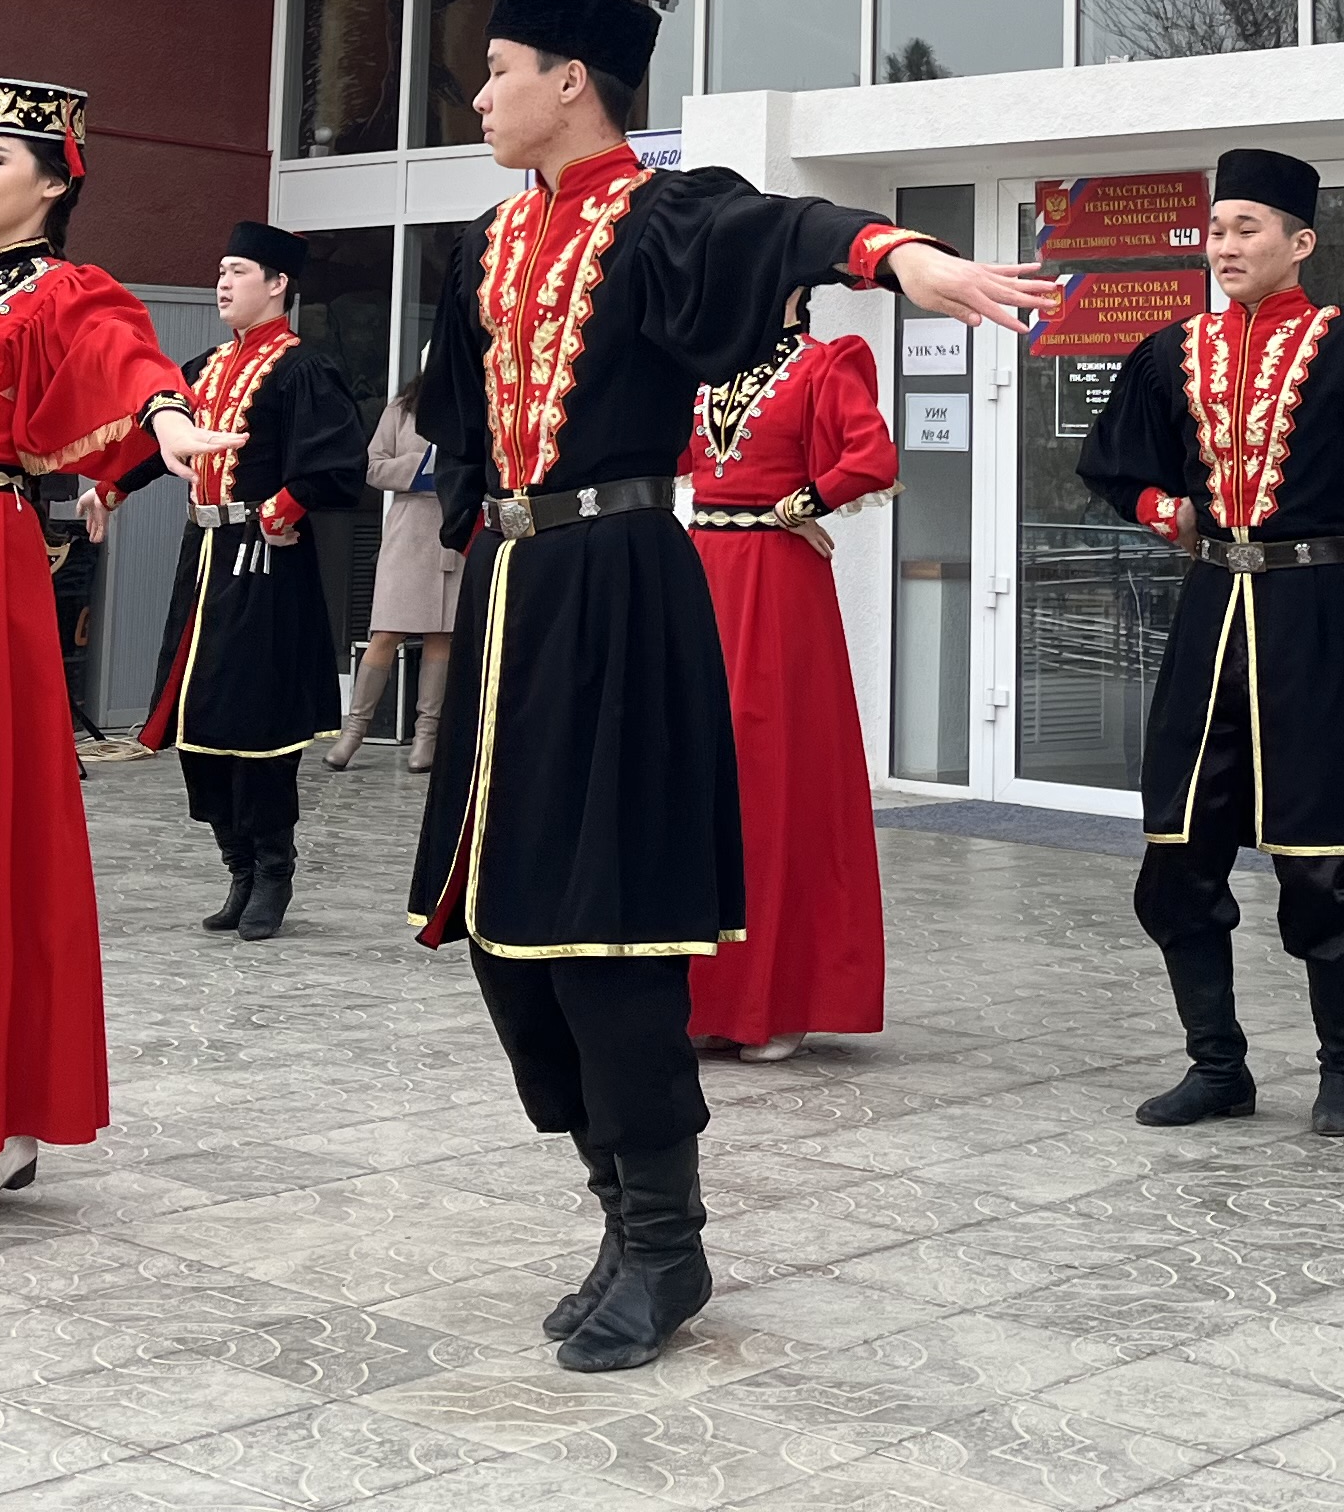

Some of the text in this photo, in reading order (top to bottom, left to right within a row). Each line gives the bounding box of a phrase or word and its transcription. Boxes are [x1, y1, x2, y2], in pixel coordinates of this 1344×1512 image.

[1097, 182, 1183, 198] УЧАСТКОВАЯ
[1085, 196, 1197, 212] ИЗБИРАТЕЛЬНАЯ
[1103, 211, 1177, 226] КОМИССИЯ
[1092, 280, 1179, 294] УЧАСТКОВАЯ
[1079, 295, 1191, 309] ИЗБИРАТЕЛЬНАЯ
[1098, 310, 1172, 323] КОМИССИЯ
[907, 345, 960, 357] УИК № 43
[924, 408, 947, 419] УИК
[921, 430, 950, 441] № 44
